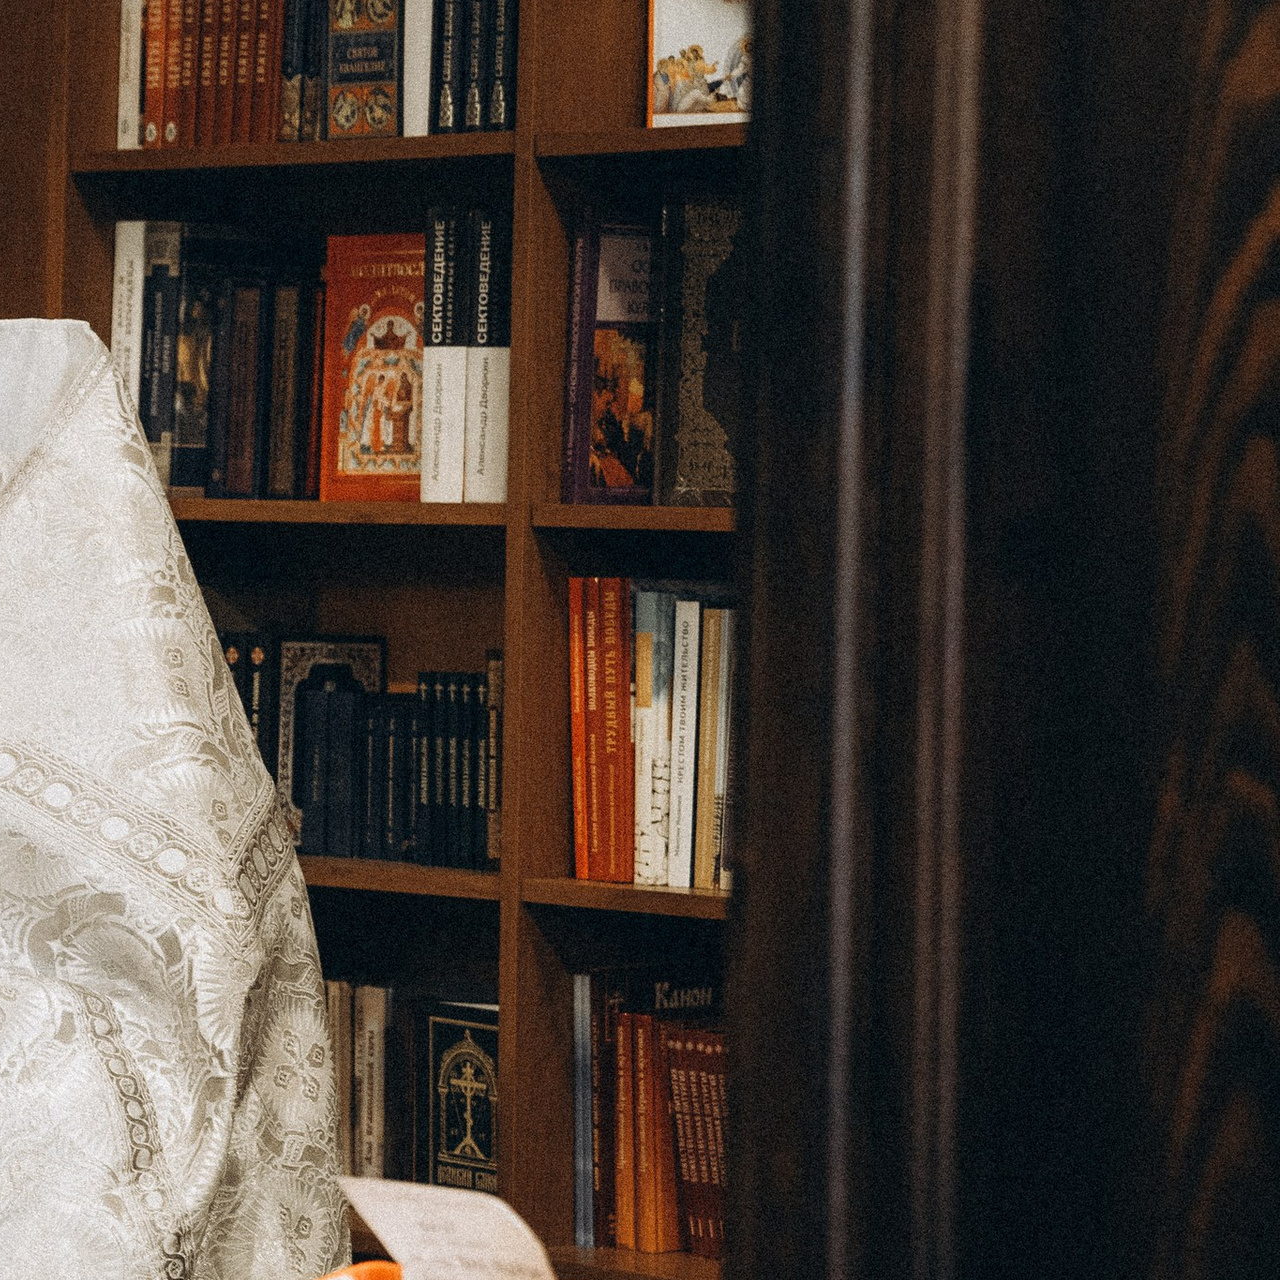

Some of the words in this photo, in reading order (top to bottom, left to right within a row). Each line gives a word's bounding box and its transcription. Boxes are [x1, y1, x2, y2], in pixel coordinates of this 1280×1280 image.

[432, 220, 445, 344] СЕКТОВЕДЕНИЕ
[477, 220, 491, 344] СЕКТОВЕДЕНИЕ
[604, 590, 616, 645] ПОБЕДЫ
[605, 651, 617, 685] ПУТЬ
[680, 620, 690, 692] ЖИТЕЛЬСТВО
[606, 691, 618, 754] ТРУДНЫЙ
[678, 694, 688, 732] ТВОИМ
[676, 734, 686, 785] КРЕСТОМ
